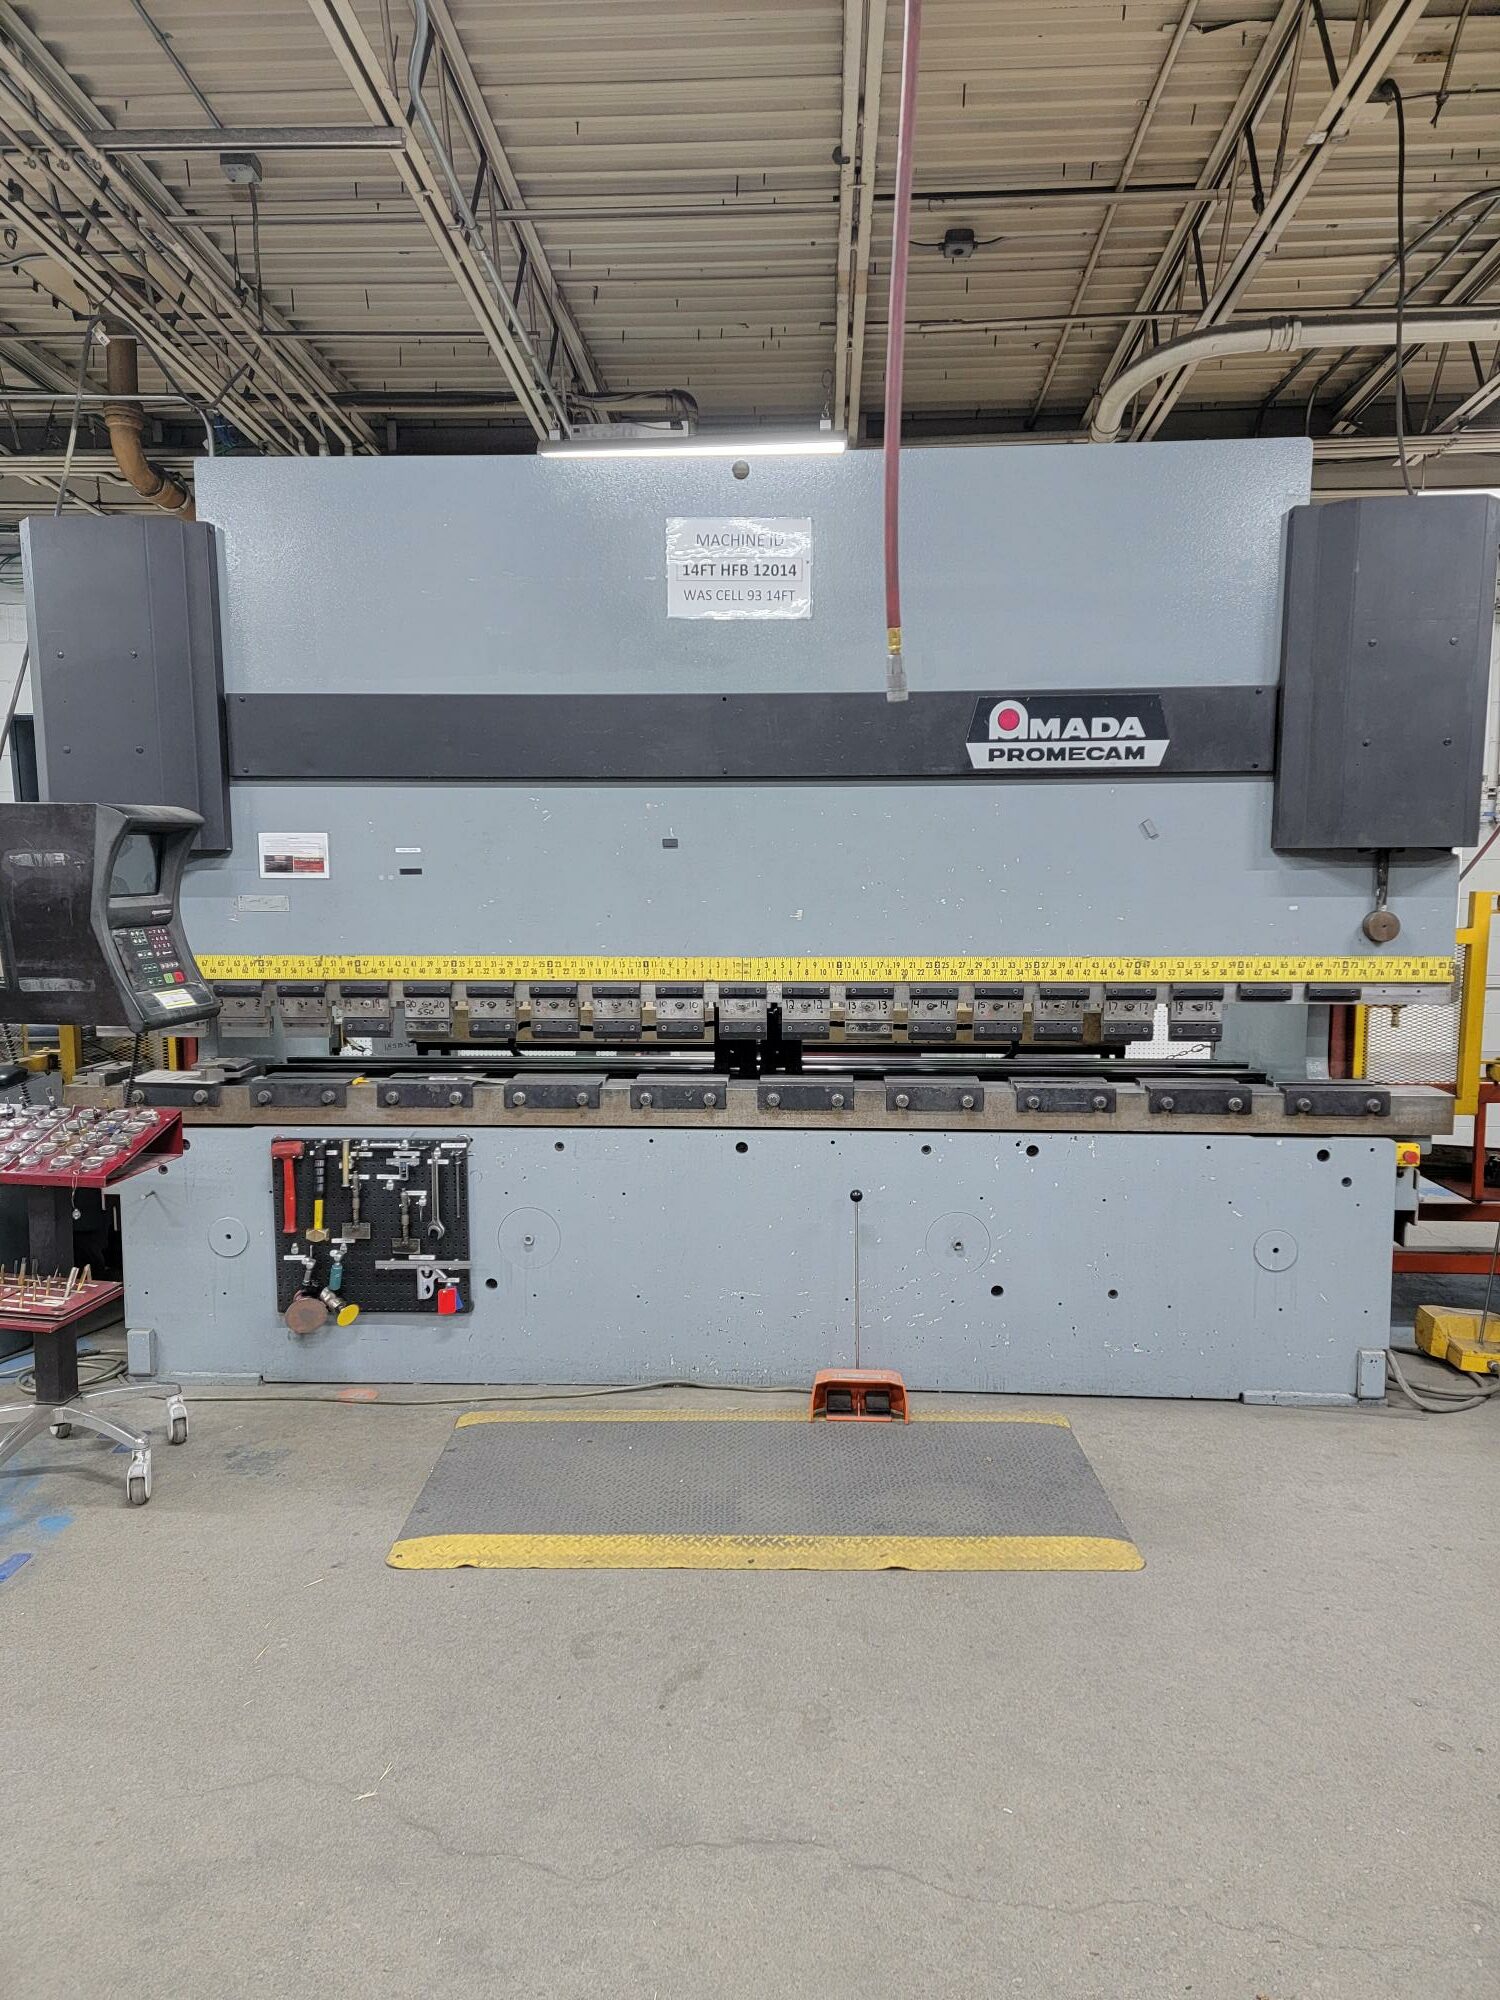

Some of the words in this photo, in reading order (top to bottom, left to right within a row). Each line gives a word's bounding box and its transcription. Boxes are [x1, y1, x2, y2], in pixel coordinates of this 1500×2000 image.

[696, 533, 763, 547] MACHINE
[682, 564, 717, 576] 14FT
[720, 564, 748, 576] HFB
[754, 564, 797, 577] 12014
[683, 589, 712, 601] WAS
[716, 590, 744, 601] CELL
[747, 590, 762, 601] 93
[767, 590, 795, 601] 14FT
[989, 700, 1146, 740] AMADA
[988, 745, 1145, 762] PROMECAM
[317, 999, 323, 1007] 4
[405, 999, 416, 1008] 20
[434, 1000, 445, 1008] 20
[568, 1000, 575, 1008] 6
[628, 1000, 633, 1008] 9
[690, 1001, 698, 1009] 10
[786, 1000, 795, 1009] 12
[814, 1000, 823, 1009] 12
[848, 1001, 857, 1010] 13
[878, 1001, 888, 1010] 13
[911, 1000, 920, 1009] 14
[940, 1000, 948, 1010] 14
[978, 1001, 986, 1010] 15
[1072, 1001, 1080, 1009] 16
[1109, 1002, 1118, 1011] 17
[1139, 1002, 1148, 1011] 17
